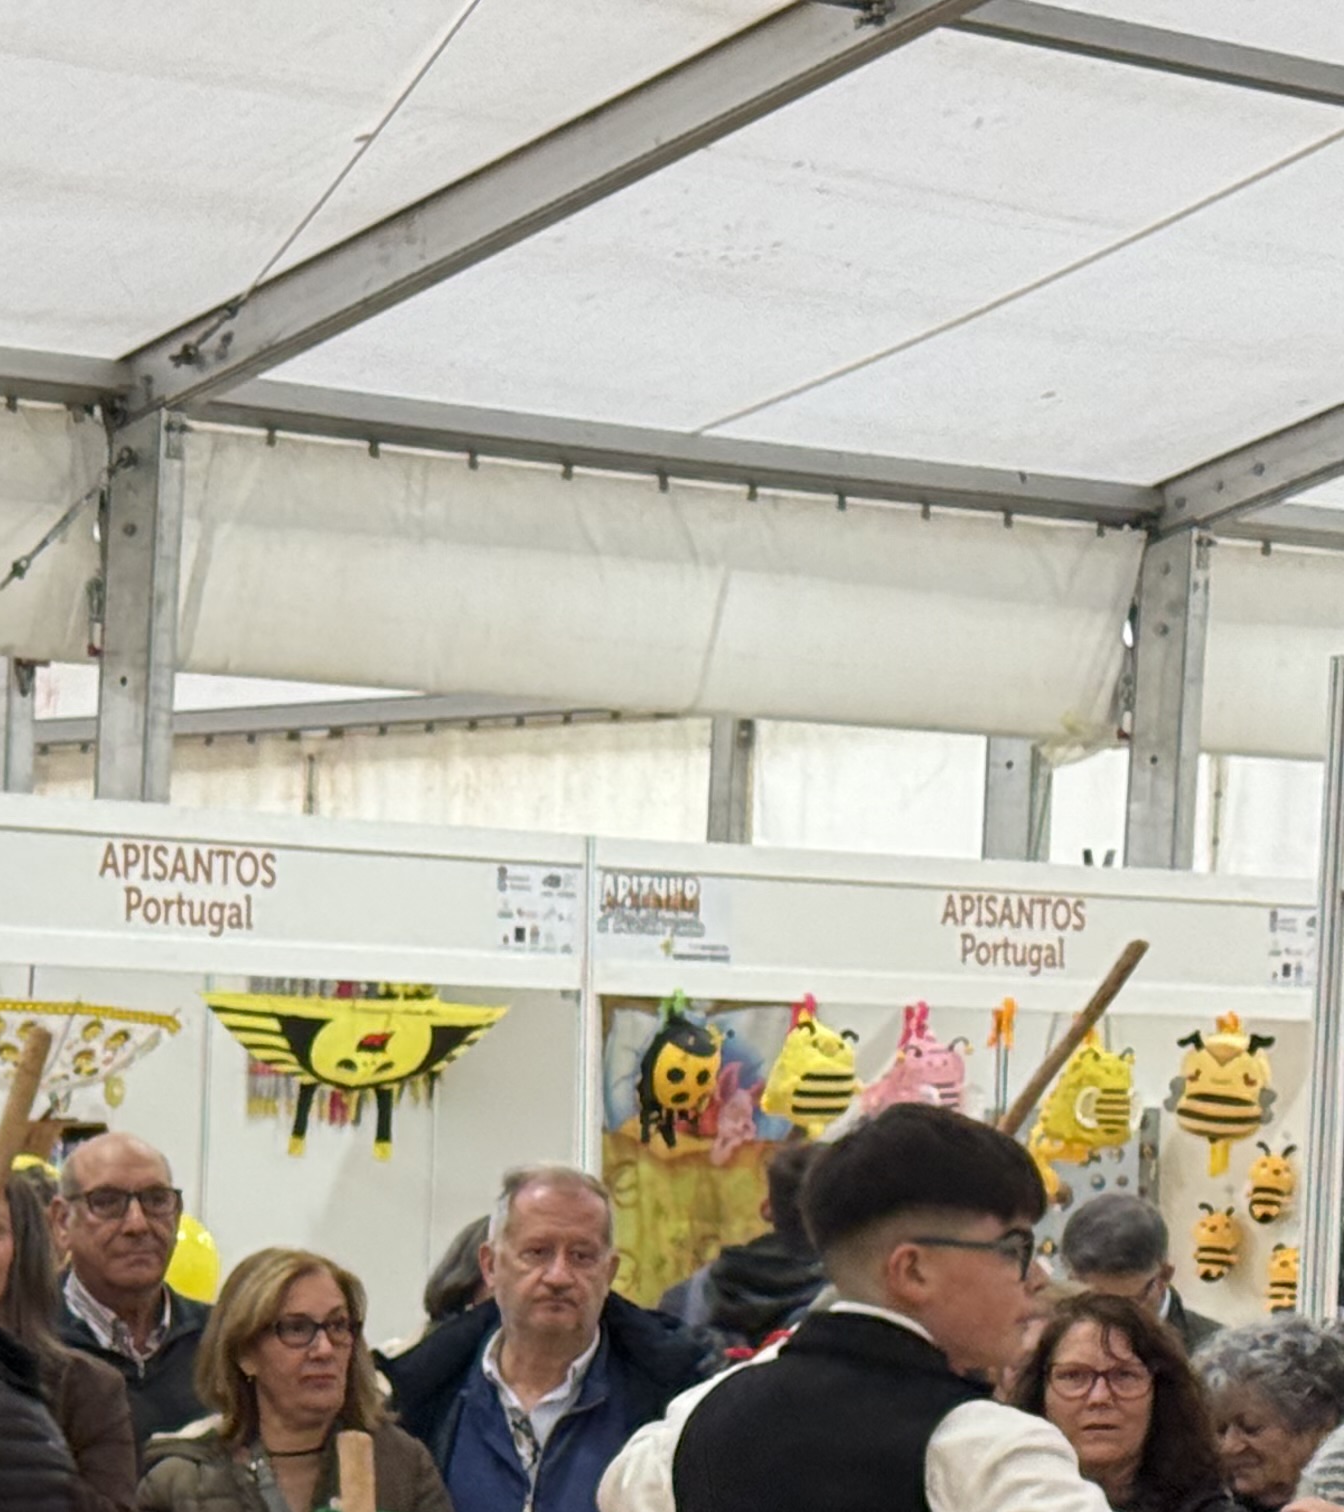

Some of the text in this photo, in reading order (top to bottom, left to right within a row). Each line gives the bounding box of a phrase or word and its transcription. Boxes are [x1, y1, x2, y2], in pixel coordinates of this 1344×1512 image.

[99, 842, 277, 888] APISANTOS
[124, 886, 253, 937] Portugal
[941, 894, 1086, 931] APISANTOS
[960, 933, 1065, 976] Portugal
